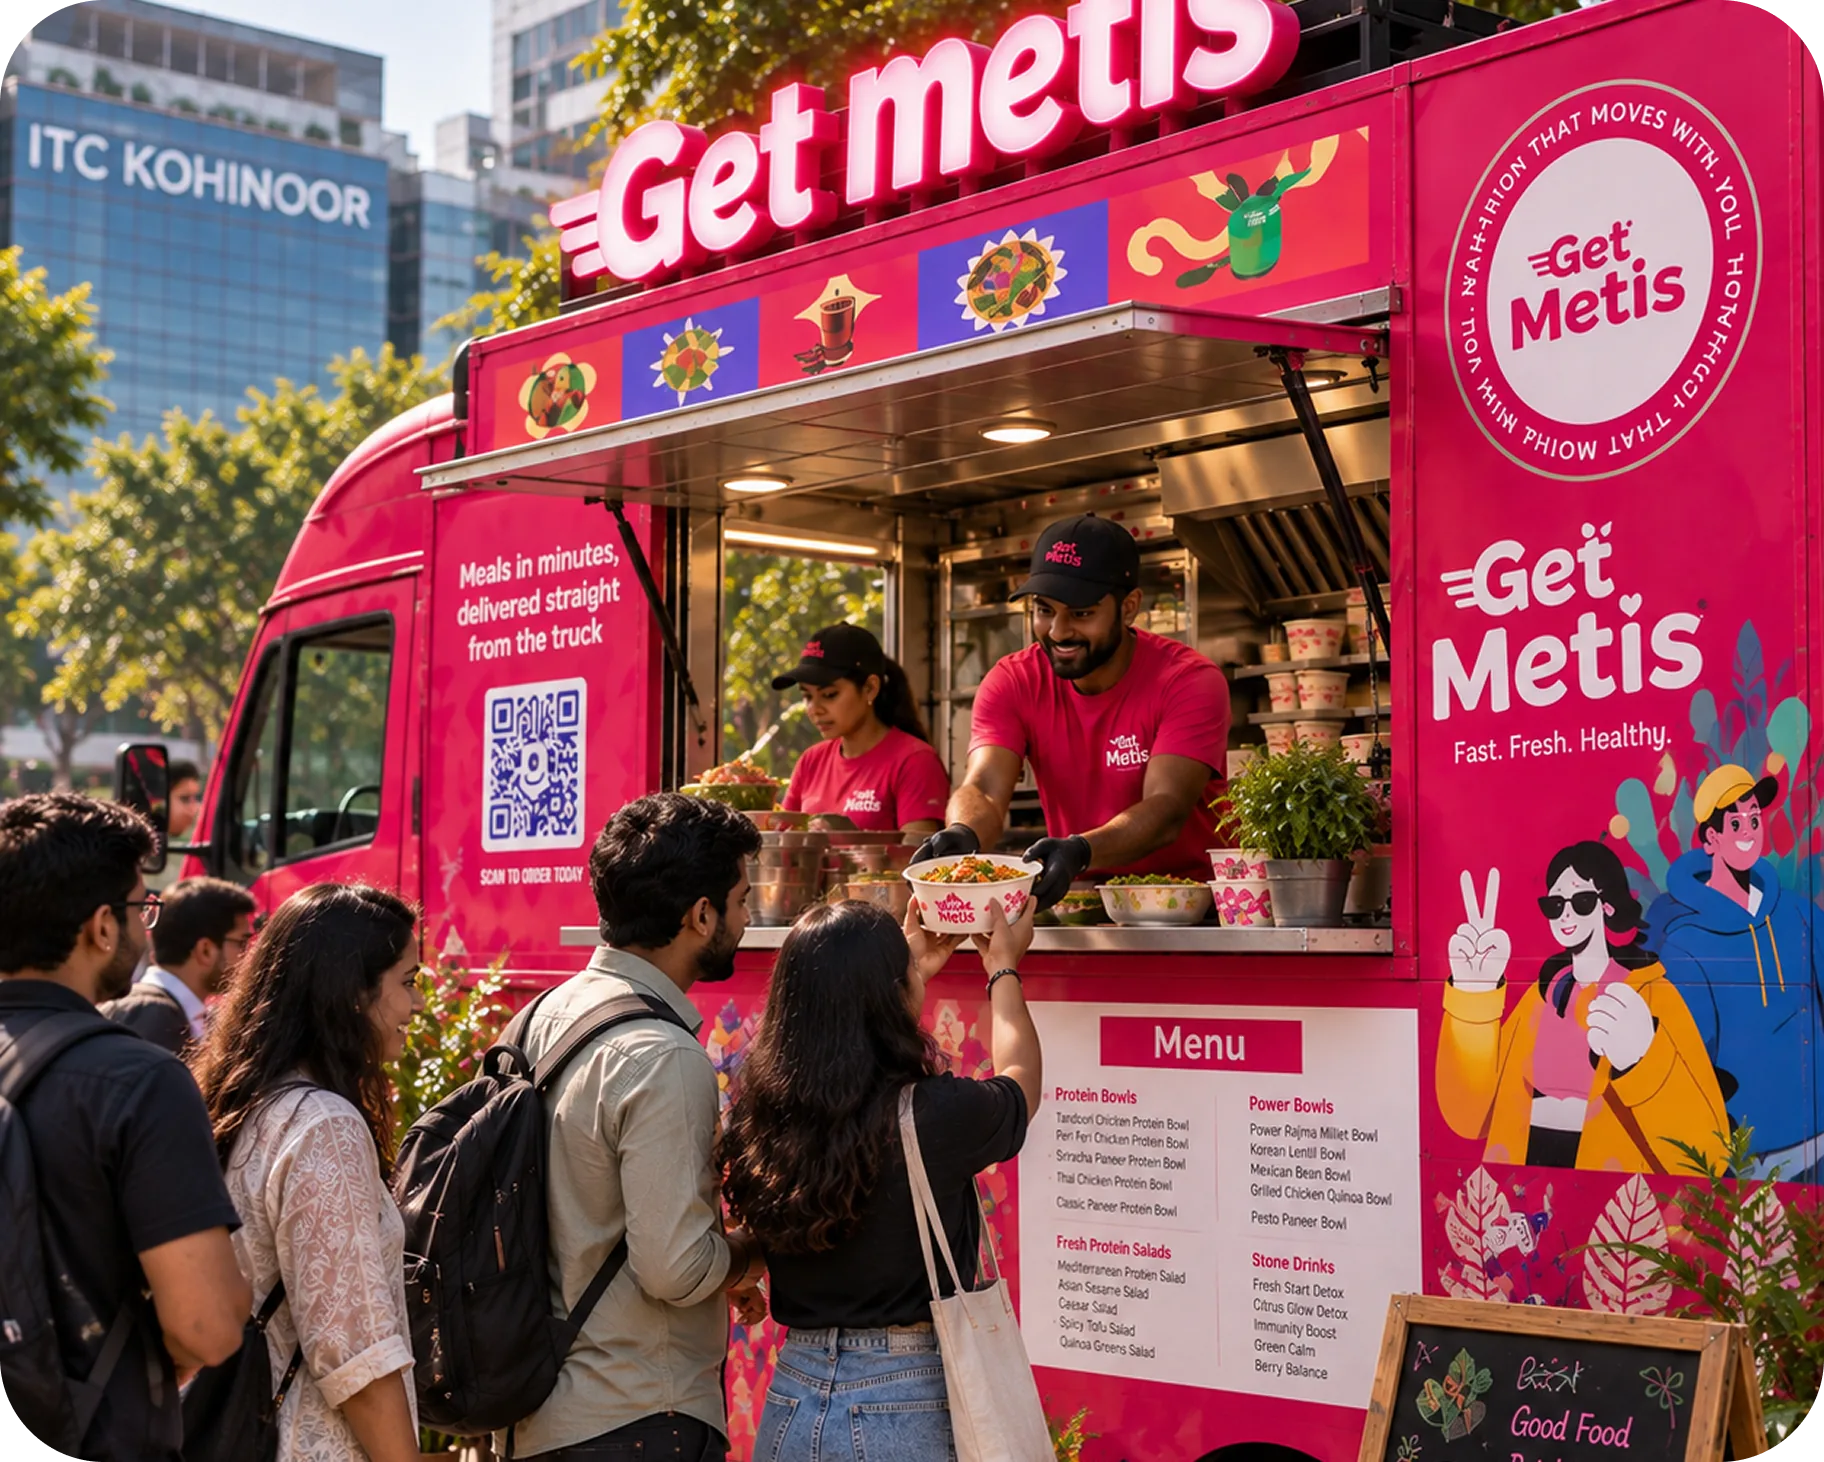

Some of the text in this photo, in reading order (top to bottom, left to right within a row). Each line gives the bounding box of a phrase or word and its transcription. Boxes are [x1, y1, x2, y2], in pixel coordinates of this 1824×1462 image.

[1528, 112, 1582, 156] THAT
[1590, 102, 1668, 130] MOVES
[28, 123, 371, 229] ITC KOHINOOR
[598, 82, 826, 282] Get
[1546, 220, 1633, 278] Get
[1509, 258, 1687, 351] Metis
[460, 542, 620, 588] Meals in minutes,
[1471, 522, 1615, 617] Get
[457, 576, 620, 626] delivered straight
[469, 617, 603, 662] from the truck
[1432, 593, 1703, 722] Metis
[1454, 721, 1672, 765] Fast. Fresh. Healthy.
[480, 868, 505, 885] SCAN
[507, 867, 520, 884] TO
[554, 866, 584, 882] TODAY
[1153, 1024, 1246, 1062] Menu
[1055, 1087, 1137, 1104] Protein Bowls
[1249, 1095, 1334, 1114] Power Bowls
[1132, 1115, 1164, 1129] Protein
[1167, 1118, 1189, 1131] Bowl
[1250, 1122, 1281, 1137] Power
[1284, 1124, 1317, 1141] Rajma
[1351, 1128, 1378, 1142] Bowl
[1132, 1134, 1164, 1148] Protein
[1166, 1136, 1189, 1150] Bowl
[1250, 1143, 1285, 1157] Korean
[1320, 1146, 1346, 1161] Bowl
[1128, 1154, 1161, 1168] Protein
[1163, 1156, 1186, 1170] Bowl
[1250, 1163, 1292, 1178] Mexican
[1325, 1167, 1351, 1182] Bowl
[1077, 1173, 1113, 1187] Chicken
[1114, 1175, 1147, 1189] Protein
[1149, 1178, 1172, 1191] Bowl
[1250, 1183, 1392, 1206] Grilled Chicken Quinoa Bowl
[1120, 1201, 1152, 1215] Protein
[1154, 1204, 1178, 1217] Bowl
[1251, 1210, 1347, 1230] Pesto Paneer Bowl
[1056, 1235, 1172, 1259] Fresh Protein Salads
[1252, 1252, 1335, 1274] Stone Drinks
[1253, 1278, 1344, 1299] Fresh Start Detox
[1253, 1298, 1349, 1320] Citrus Glow Detox
[1254, 1318, 1337, 1340] Immunity Boost
[1129, 1344, 1155, 1359] Salad
[1254, 1338, 1316, 1357] Green Calm
[1255, 1359, 1328, 1380] Berry Balance
[1511, 1404, 1634, 1448] Good Food
